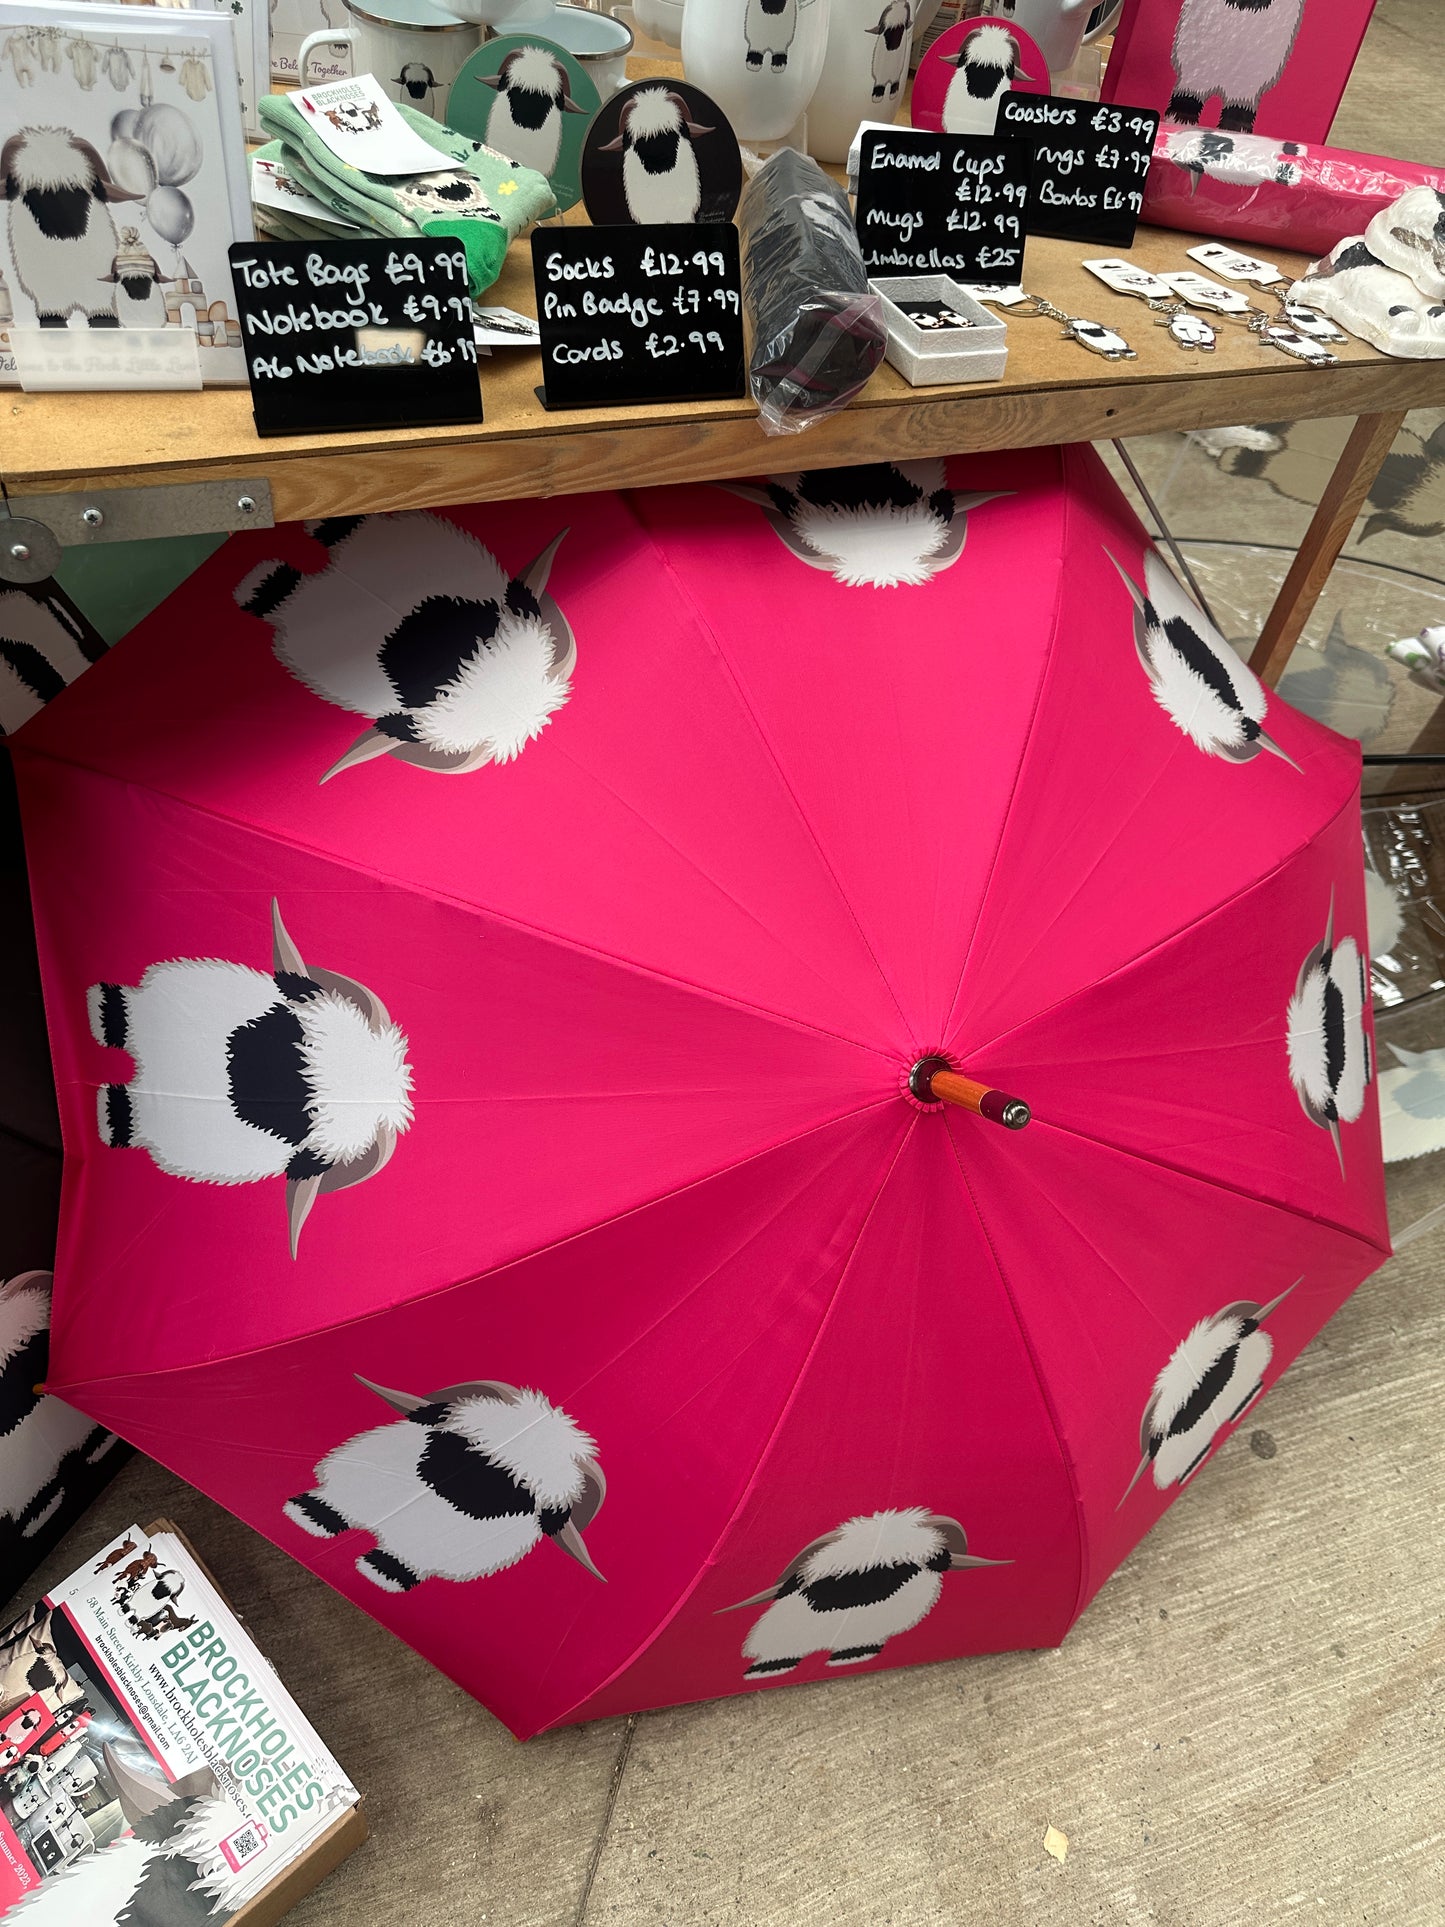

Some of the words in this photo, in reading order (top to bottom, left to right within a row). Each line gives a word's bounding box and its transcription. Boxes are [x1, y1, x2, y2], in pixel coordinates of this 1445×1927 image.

[311, 61, 348, 80] Together
[311, 84, 361, 100] BROCKHOLES
[316, 90, 366, 107] BLACKNOSES
[1005, 102, 1077, 125] Coasters
[1090, 107, 1155, 144] £3.99
[871, 143, 941, 171] Enamel
[952, 149, 1006, 184] Cups
[1094, 144, 1151, 177] £7.99
[955, 177, 1027, 208] £12.99
[1103, 186, 1144, 215] £6.99
[946, 208, 1020, 239] £12.99
[546, 252, 615, 281] Socks
[640, 247, 725, 277] £12.99
[862, 247, 966, 269] Umbrellas
[975, 246, 1020, 269] £25
[232, 259, 299, 288] Tote
[306, 253, 370, 305] Bags
[385, 252, 469, 286] £9.99
[246, 302, 389, 335] Notebook
[403, 294, 473, 323] £9.99
[544, 292, 577, 319] Pin
[582, 290, 664, 327] Badge
[672, 286, 739, 315] £7.99
[252, 356, 293, 379] A6
[296, 344, 415, 374] Notebook
[645, 331, 724, 358] £2.99
[86, 1597, 98, 1609] 58
[93, 1606, 110, 1630] Main
[106, 1626, 125, 1654] Street,
[122, 1649, 145, 1683] Kirkby
[141, 1680, 168, 1725] Lonsdale,
[167, 1721, 185, 1745] LA6
[180, 1742, 199, 1765] 2AJ
[94, 1634, 171, 1750] brockholesblacknoses@gmail.com
[186, 1620, 324, 1811] BROCKHOLES
[160, 1640, 298, 1834] BLACKNOSES
[0, 1831, 17, 1866] Summer
[14, 1864, 32, 1890] 2023,
